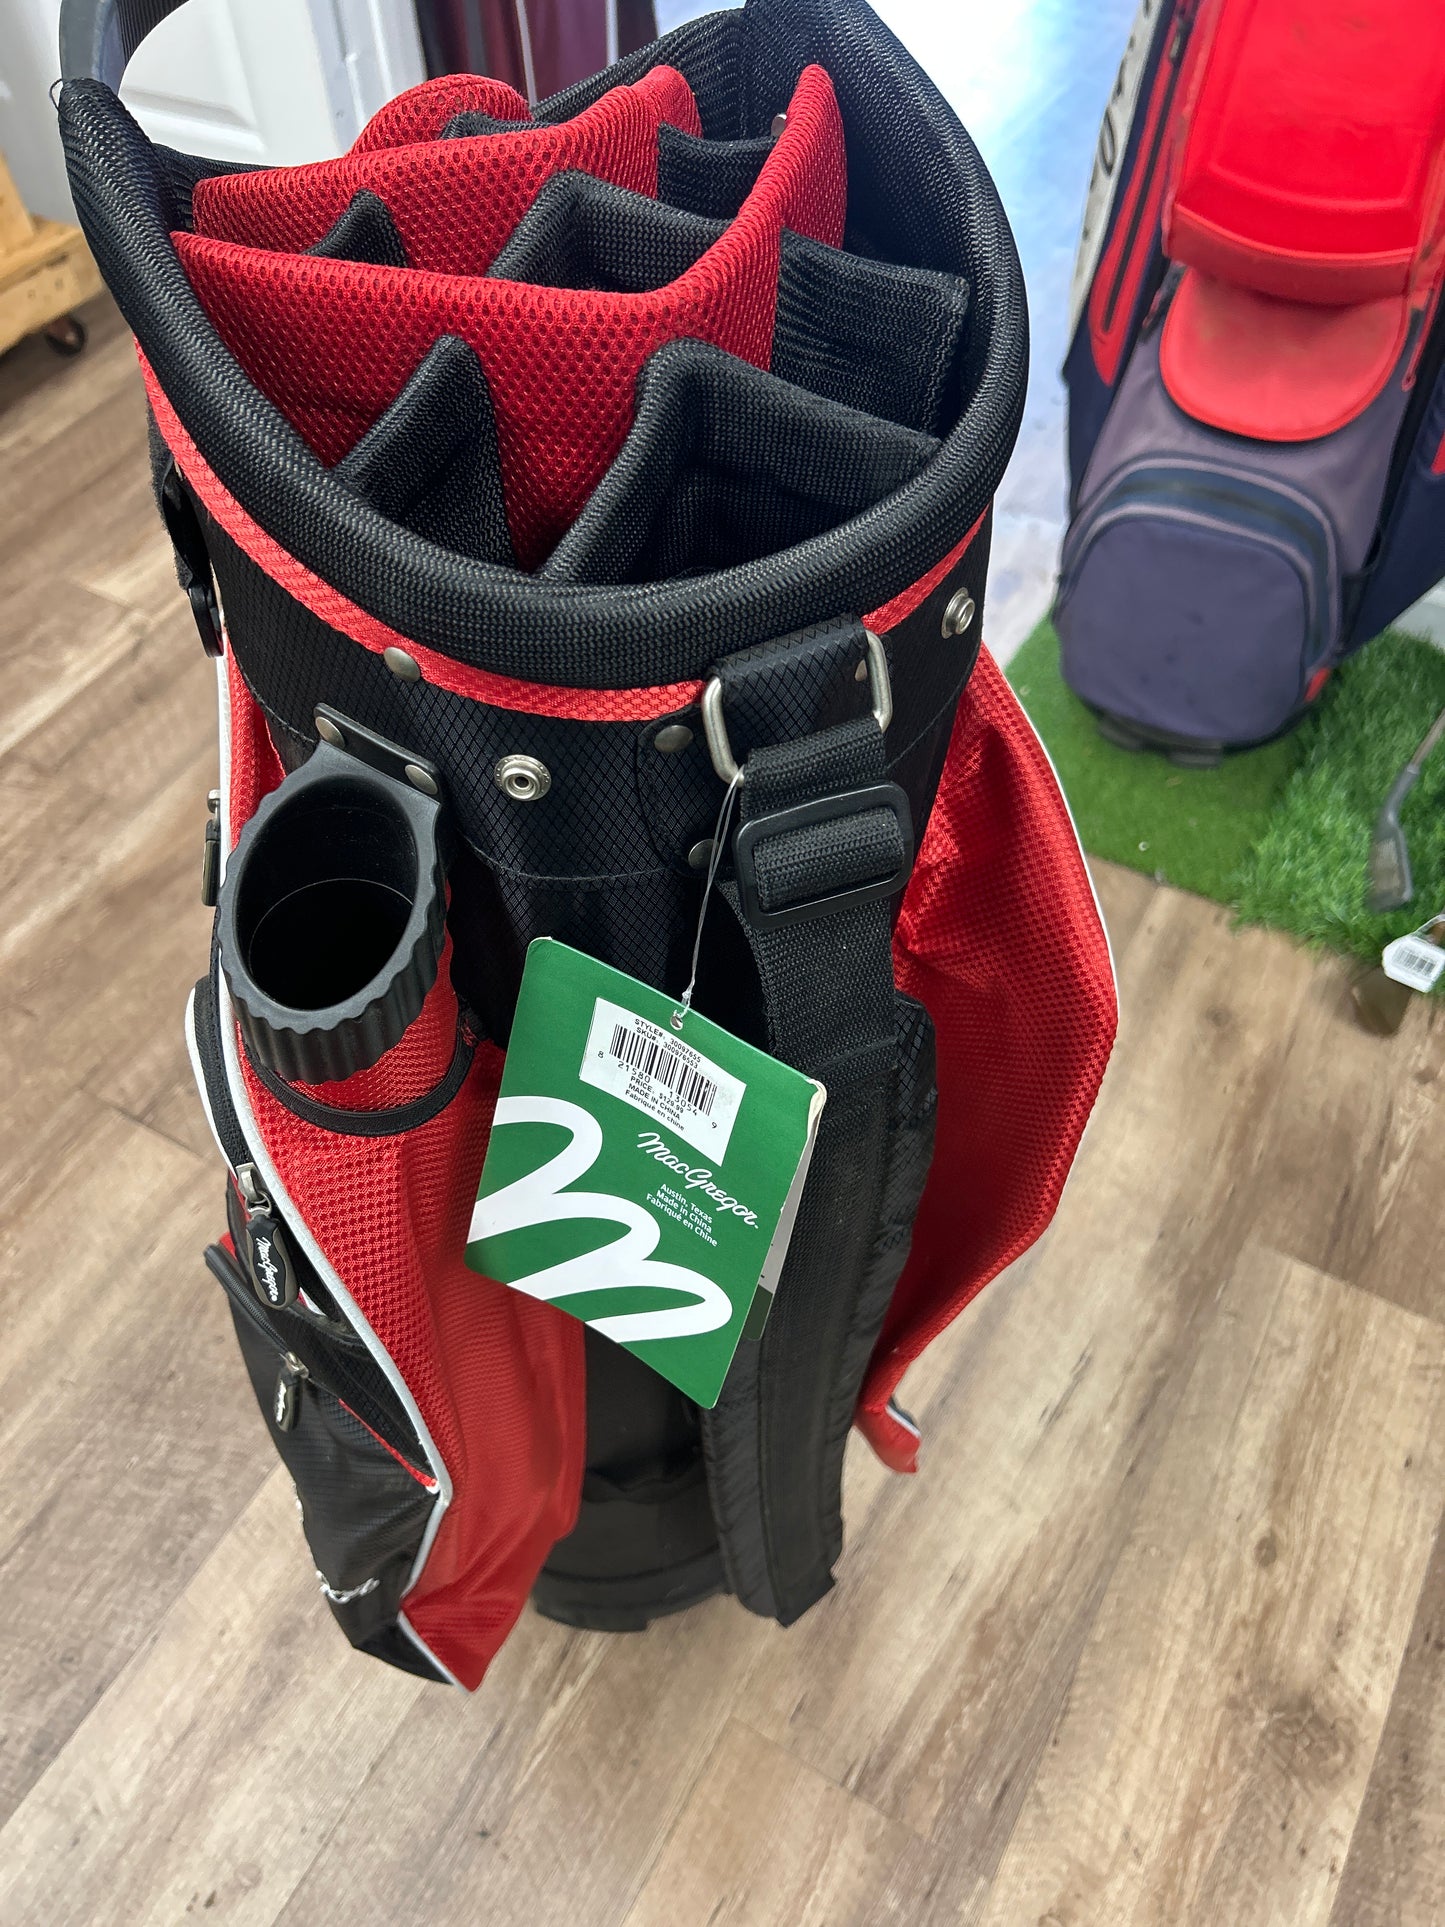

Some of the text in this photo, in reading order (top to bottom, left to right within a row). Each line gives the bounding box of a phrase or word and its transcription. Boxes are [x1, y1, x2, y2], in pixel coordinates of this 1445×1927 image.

[598, 1050, 718, 1129] 8 21580 13054 9
[628, 1083, 681, 1120] MADE IN CHINA
[659, 1092, 685, 1114] $129.99
[656, 1109, 666, 1118] en
[666, 1115, 685, 1131] chine
[656, 1190, 712, 1234] Made in China
[660, 1183, 713, 1224] Austin, Texas
[682, 1219, 693, 1230] en
[694, 1226, 718, 1247] Chine
